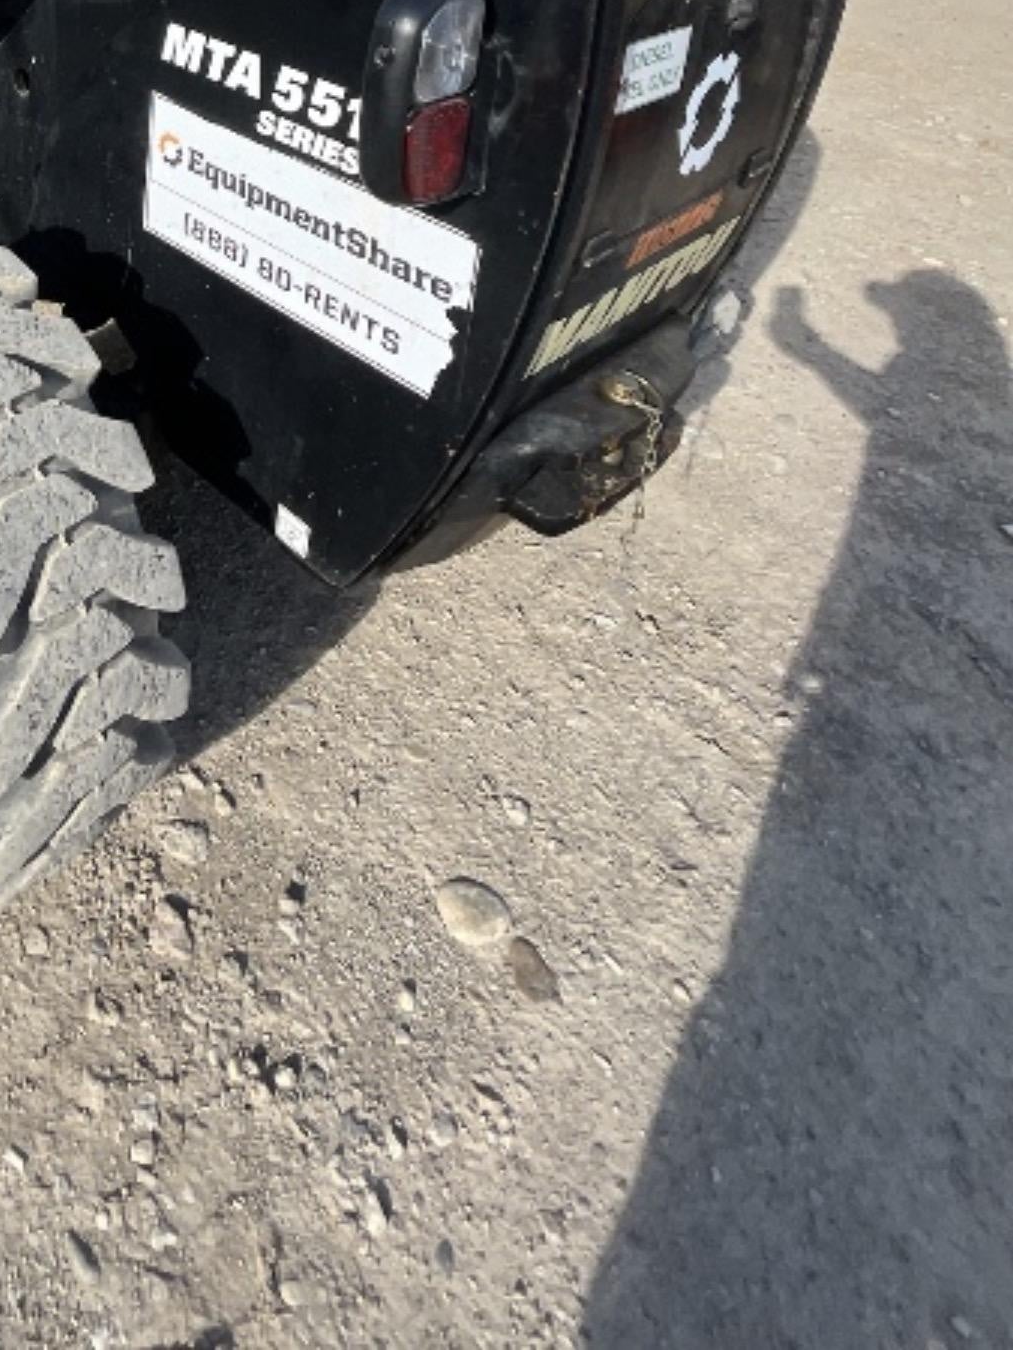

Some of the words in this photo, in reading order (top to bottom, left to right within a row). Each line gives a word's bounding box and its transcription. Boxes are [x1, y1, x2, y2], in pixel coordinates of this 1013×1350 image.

[161, 22, 261, 98] MTA
[255, 111, 359, 176] SERIES
[187, 146, 454, 303] EquipmentShare
[183, 212, 249, 268] (888)
[257, 255, 401, 356] 80-RENTS
